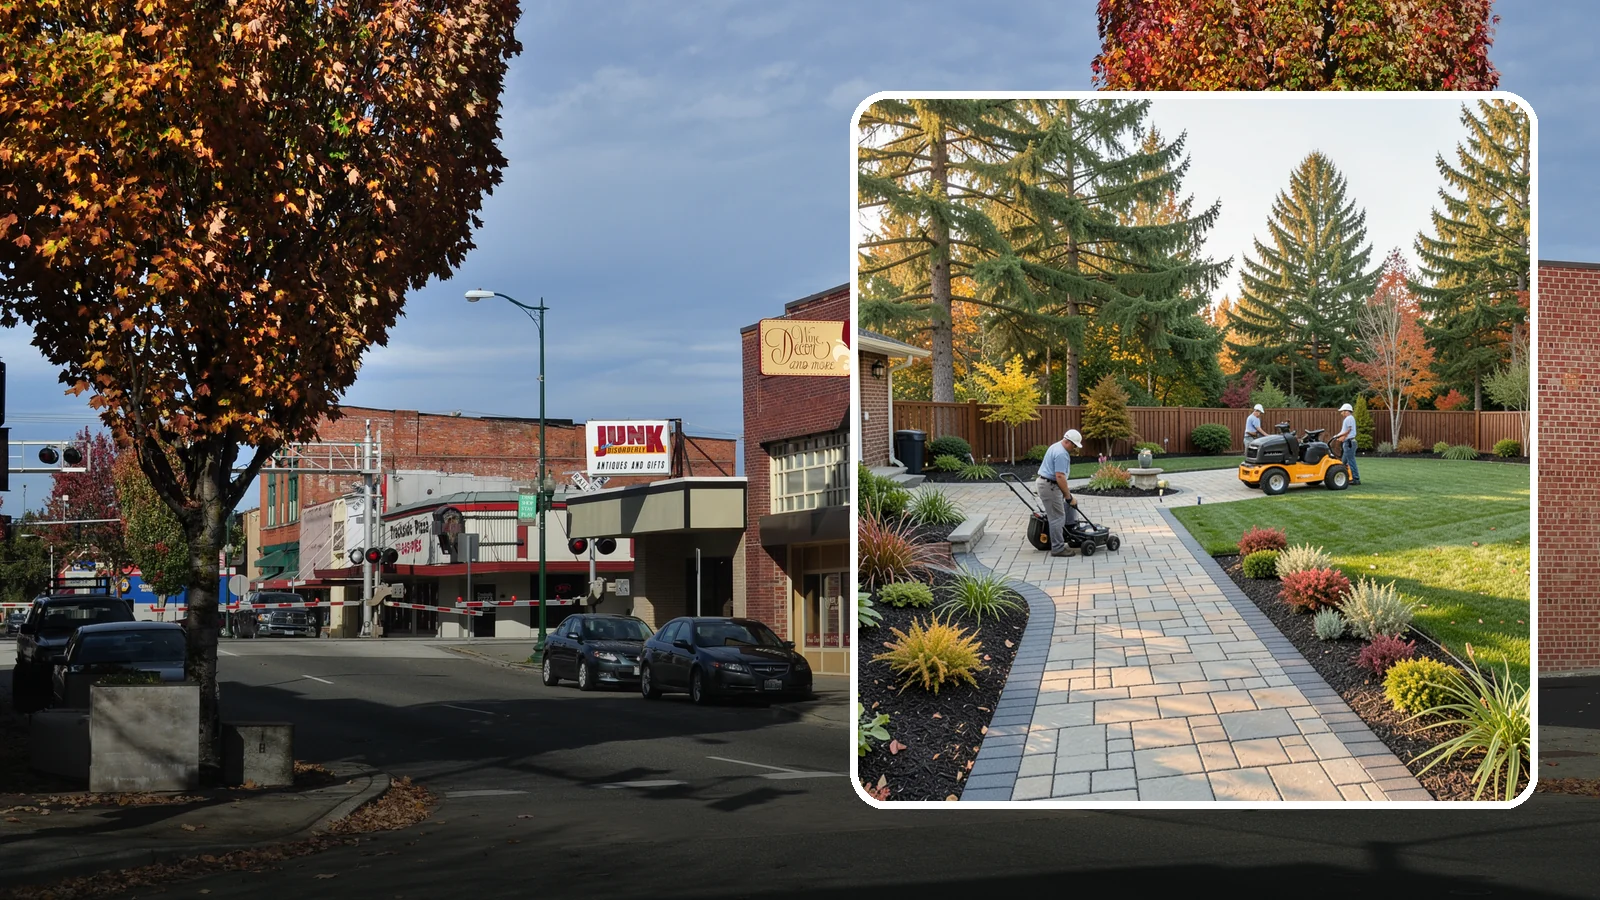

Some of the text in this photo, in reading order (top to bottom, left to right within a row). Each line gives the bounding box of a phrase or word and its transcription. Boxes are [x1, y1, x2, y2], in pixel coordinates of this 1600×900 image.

[595, 425, 665, 457] JUNK
[607, 445, 646, 454] DISORDERLY
[596, 460, 665, 470] ANTIQUES AND GIFTS
[573, 473, 588, 491] RAIL
[390, 519, 429, 540] Trackside Pizza
